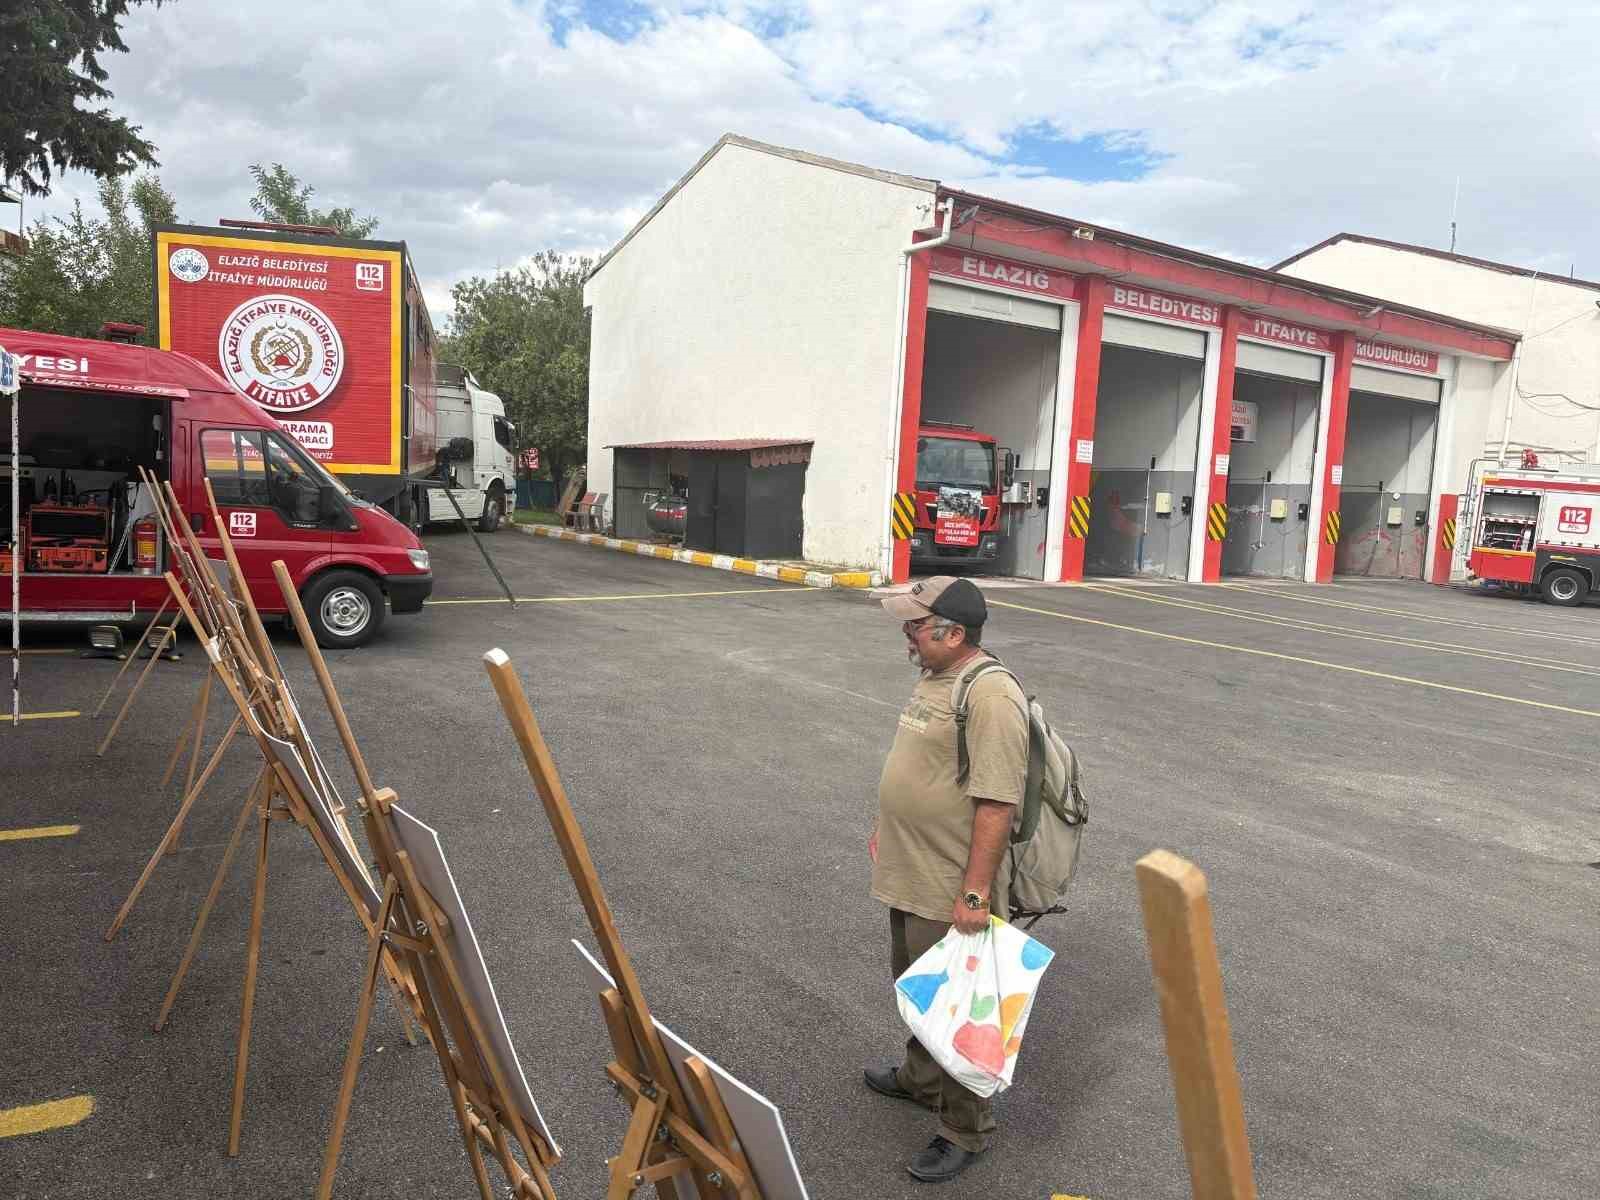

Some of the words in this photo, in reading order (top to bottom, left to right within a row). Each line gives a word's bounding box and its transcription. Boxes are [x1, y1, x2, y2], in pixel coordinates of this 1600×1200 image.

[218, 255, 260, 268] ELAZIĞ
[262, 259, 329, 273] BELEDİYESİ
[360, 265, 380, 279] 112
[962, 256, 1049, 289] ELAZIĞ
[208, 269, 255, 285] İTFAİYE
[256, 275, 328, 291] MÜDÜRLÜĞÜ
[1113, 286, 1219, 323] BELEDİYESİ
[228, 326, 243, 374] ELAZIĞ
[236, 302, 287, 328] İTFAİYE
[289, 305, 337, 377] MÜDÜRLÜĞÜ
[251, 385, 312, 406] İTFAİYE
[233, 514, 253, 526] 112
[1565, 510, 1586, 523] 112
